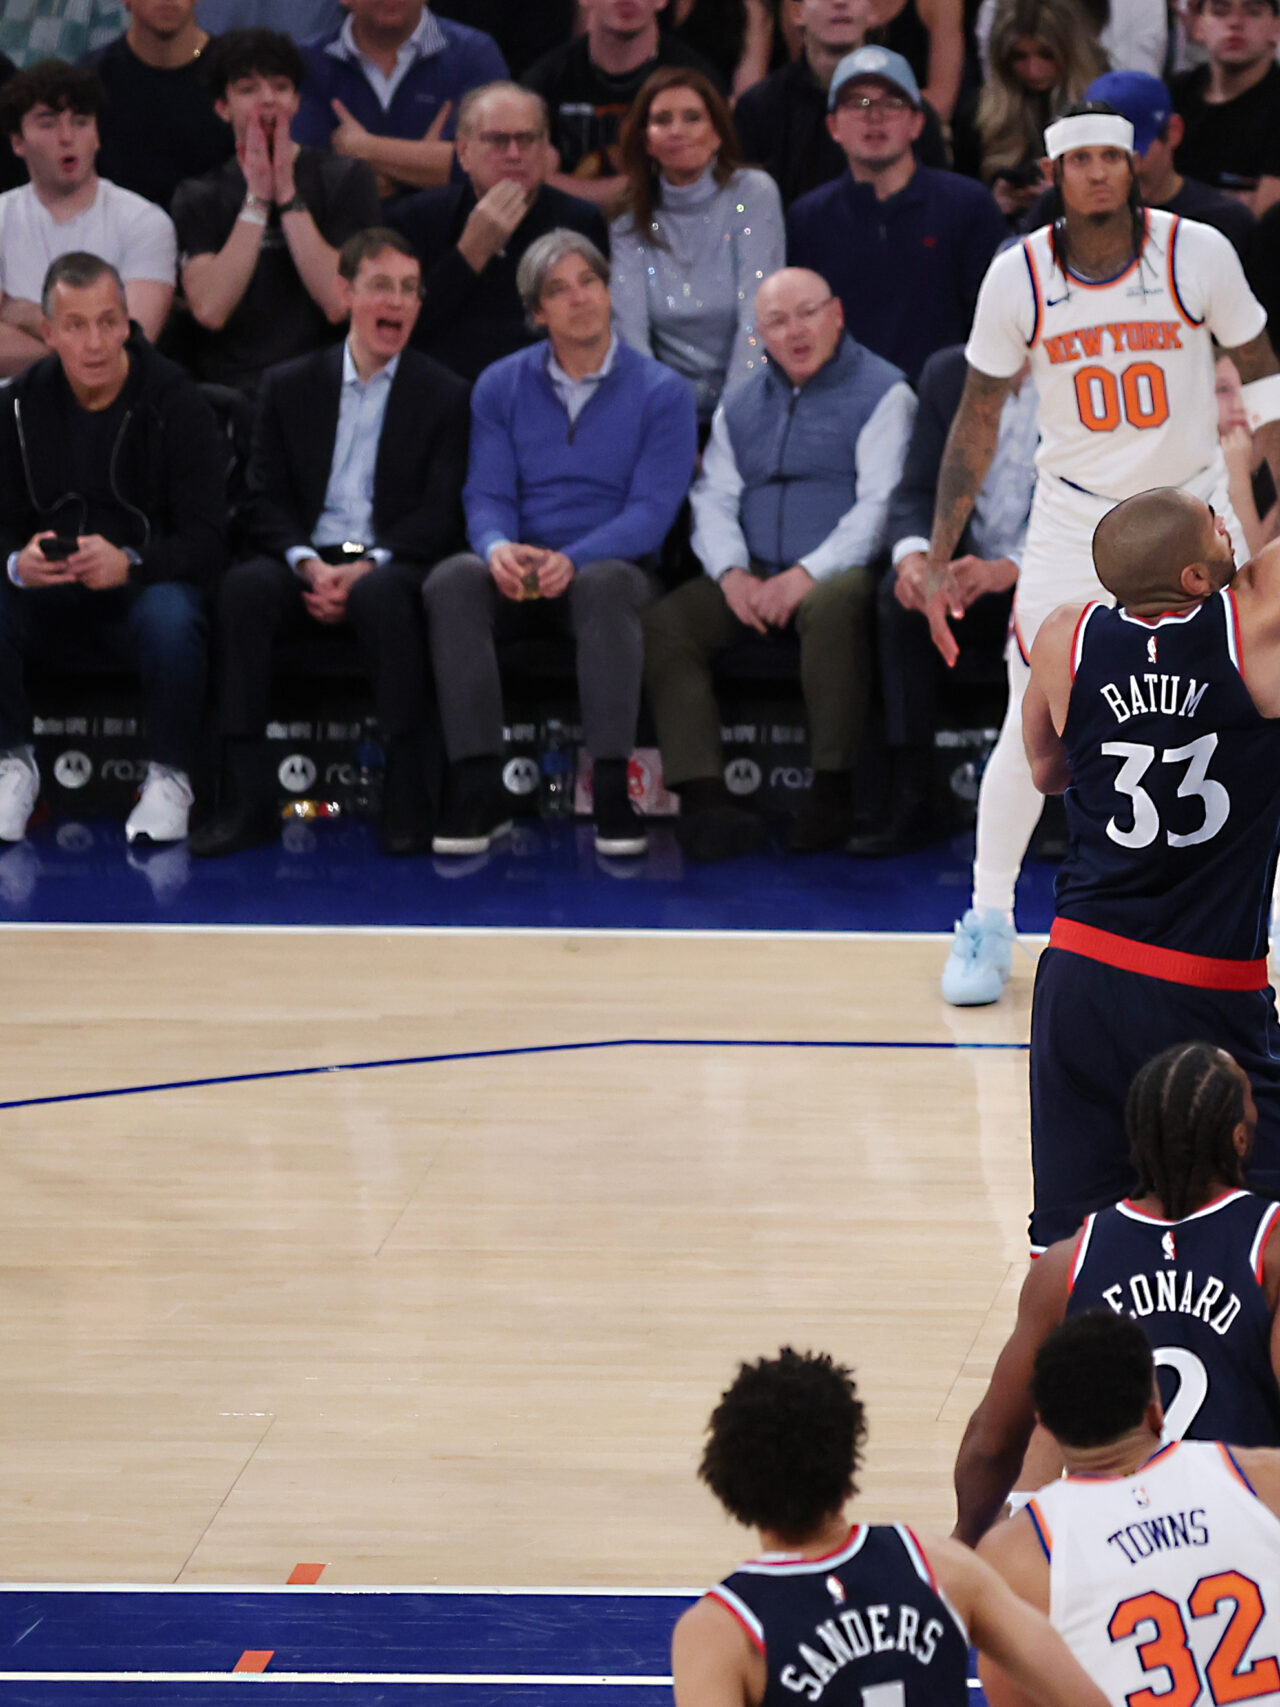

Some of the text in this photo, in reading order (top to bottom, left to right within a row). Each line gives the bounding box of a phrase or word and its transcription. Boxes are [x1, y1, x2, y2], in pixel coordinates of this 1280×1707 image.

[1043, 321, 1183, 364] NEW YORK
[1074, 361, 1170, 432] 00
[1100, 673, 1209, 724] BATUM
[101, 759, 147, 782] raz
[770, 767, 815, 790] raz
[1101, 732, 1231, 849] 33
[1102, 1270, 1242, 1335] EONARD
[1107, 1509, 1209, 1565] TOWNS
[780, 1604, 944, 1702] SANDERS
